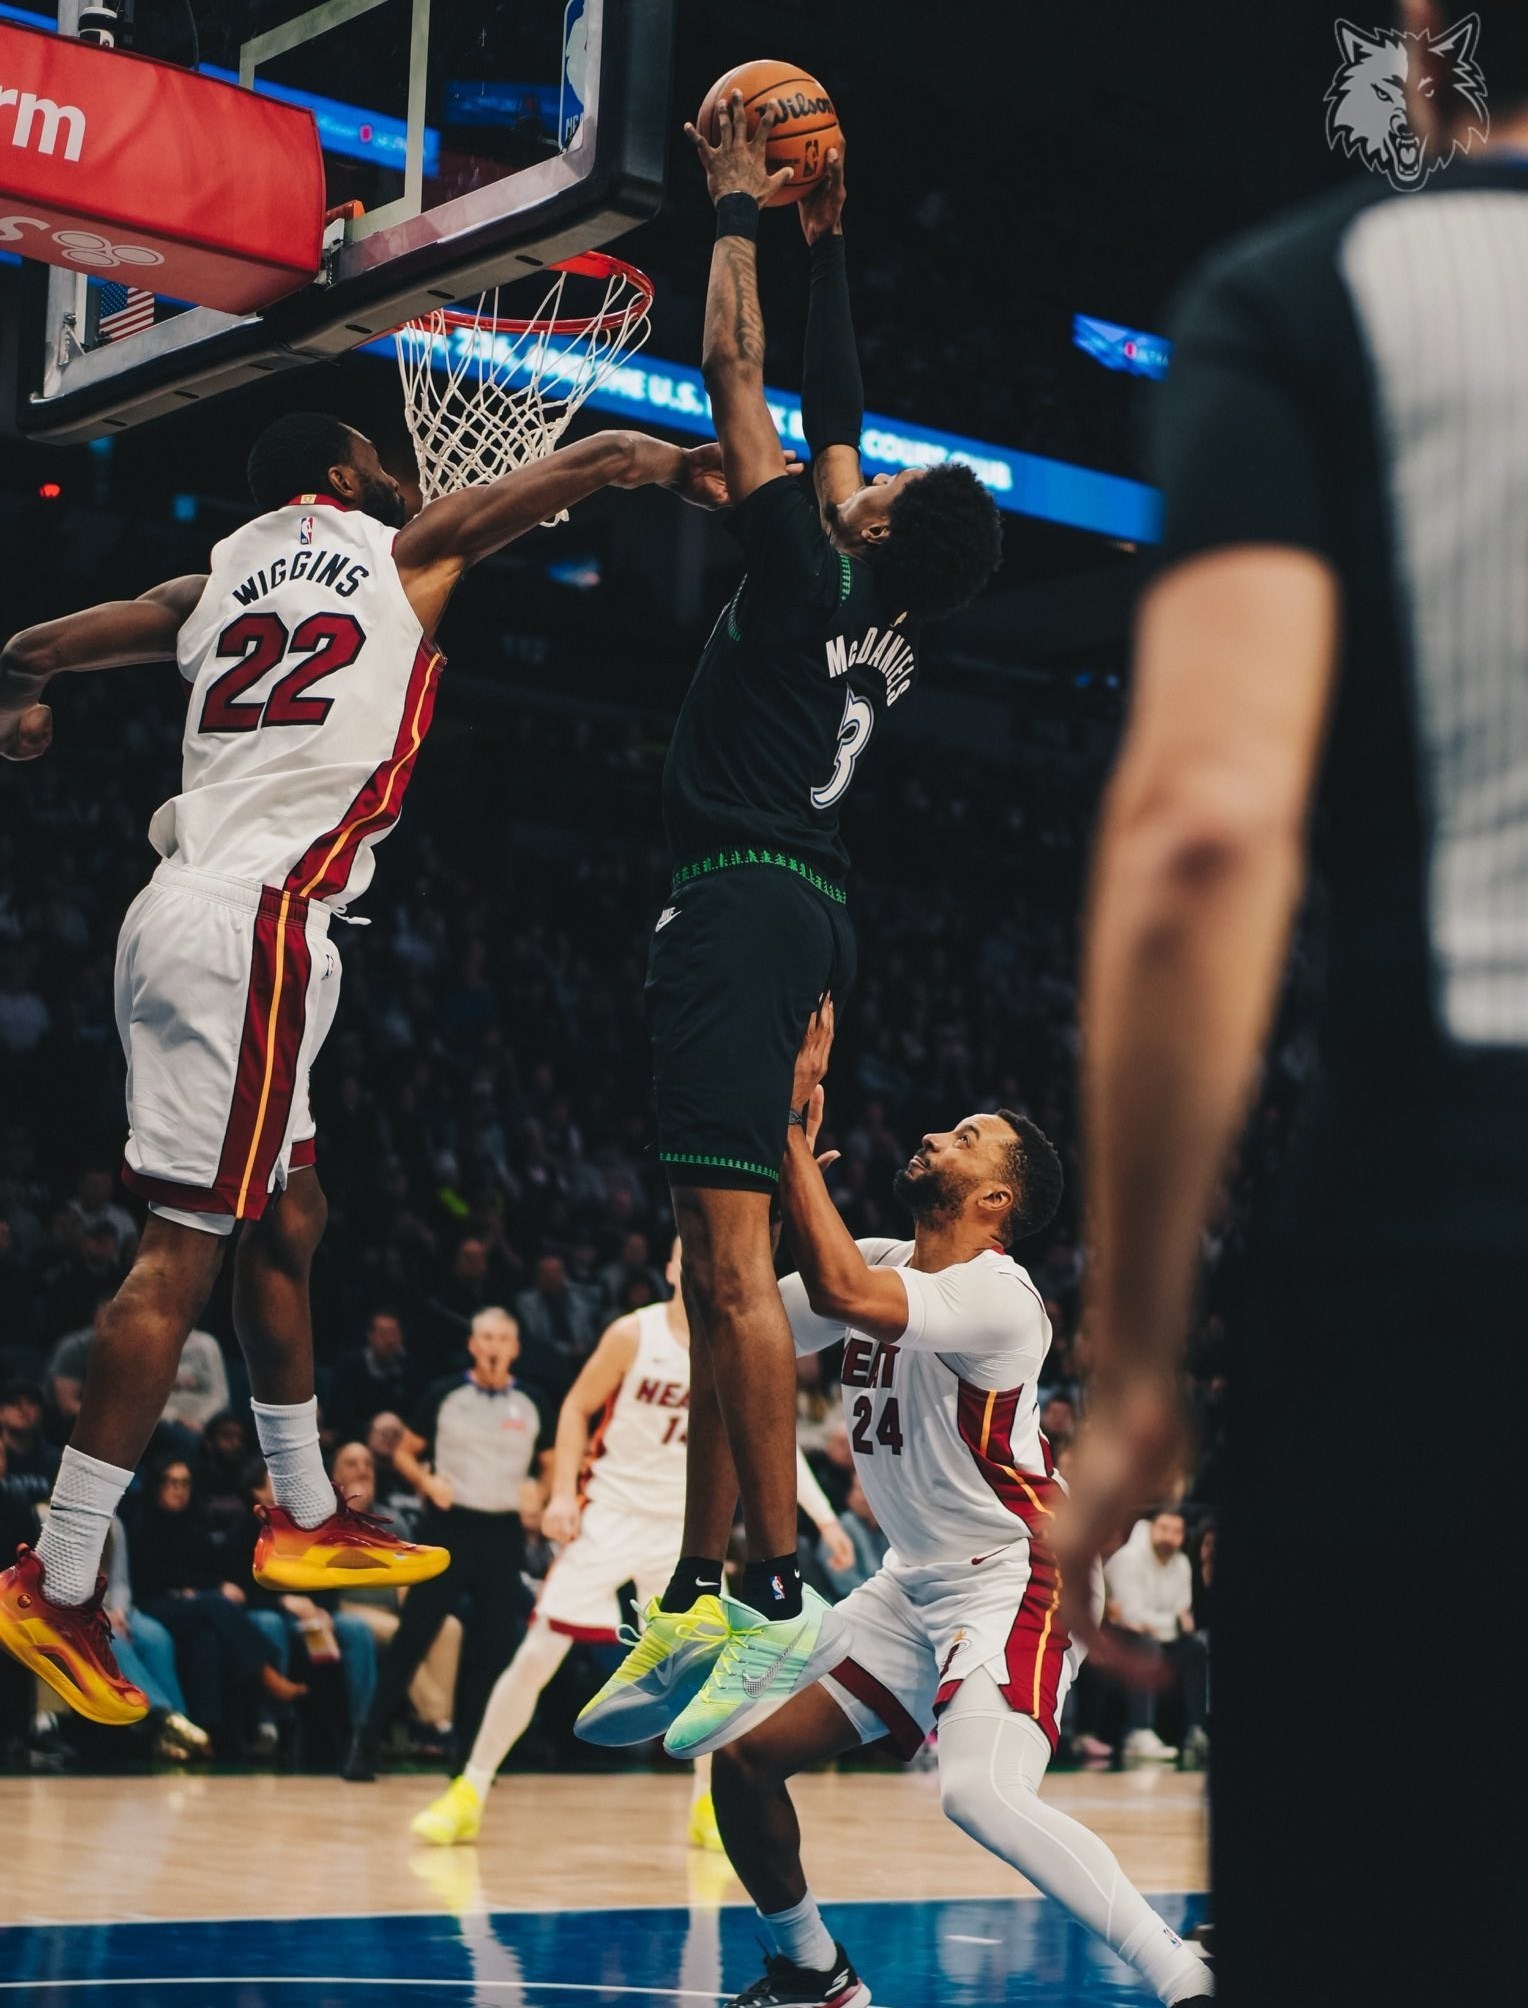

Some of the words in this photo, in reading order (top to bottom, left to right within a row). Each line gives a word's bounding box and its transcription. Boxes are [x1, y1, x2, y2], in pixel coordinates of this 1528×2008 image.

[232, 551, 369, 606] WIGGINS
[198, 611, 367, 734] 22
[810, 682, 875, 810] 3
[852, 1395, 903, 1456] 24
